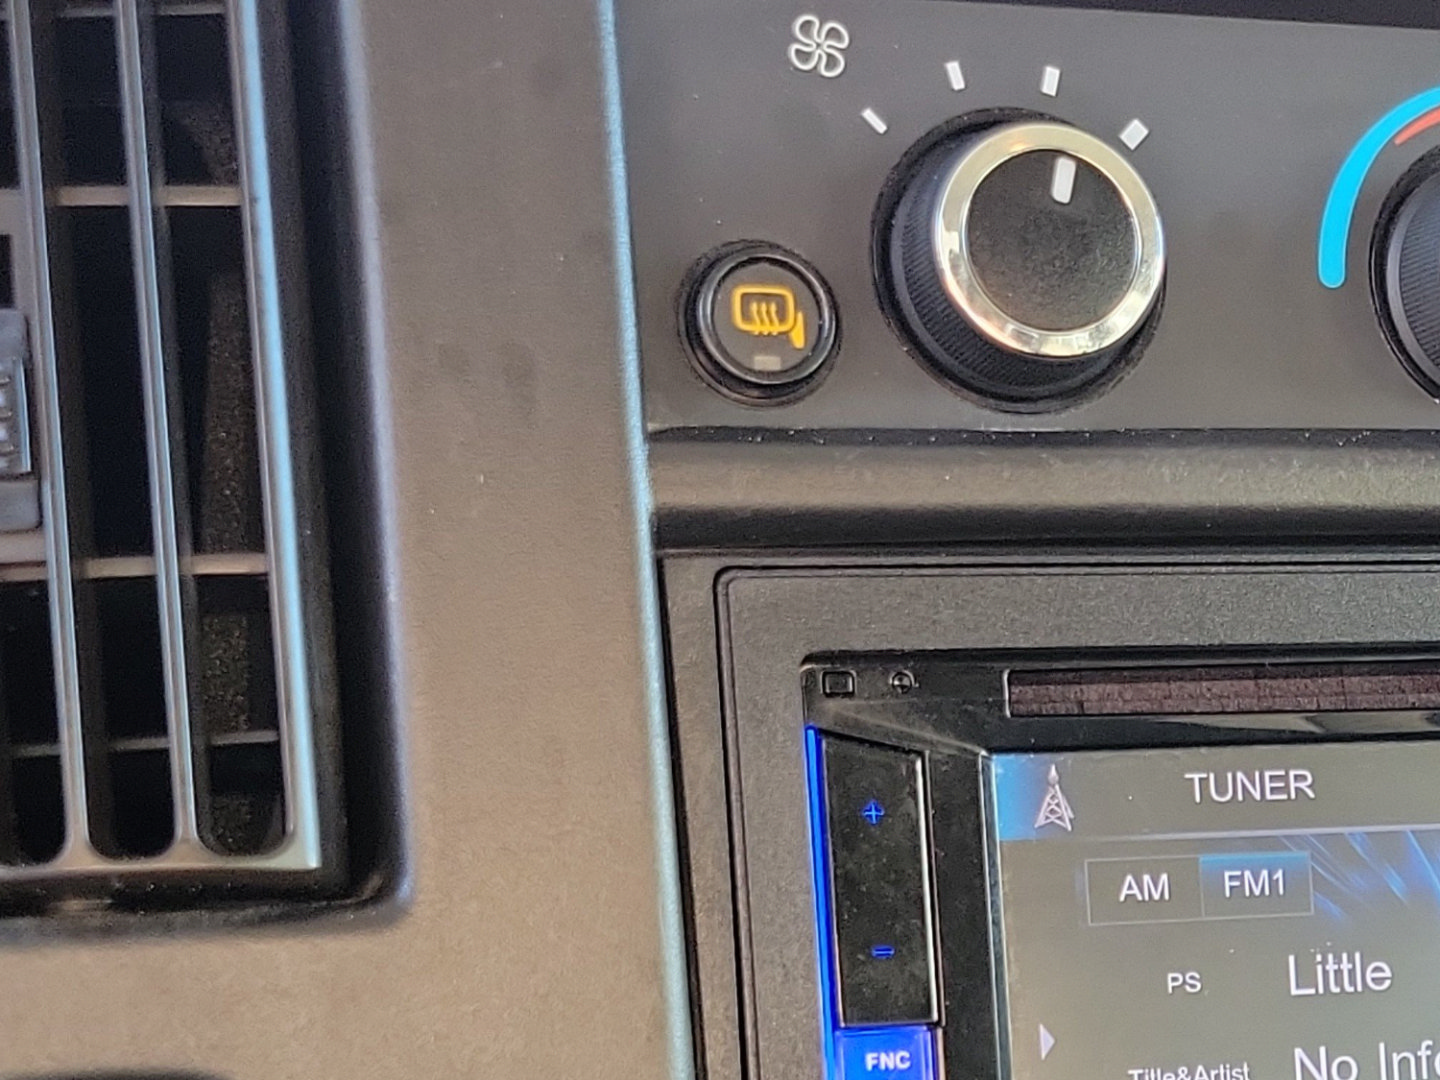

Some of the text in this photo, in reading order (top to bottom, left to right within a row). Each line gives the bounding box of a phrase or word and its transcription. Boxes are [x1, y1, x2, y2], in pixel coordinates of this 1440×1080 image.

[1184, 769, 1316, 804] TUNER
[1118, 873, 1171, 902] AM
[1223, 868, 1287, 898] FM1
[1166, 972, 1203, 995] PS
[1287, 951, 1394, 998] Little
[865, 1050, 912, 1072] FNC
